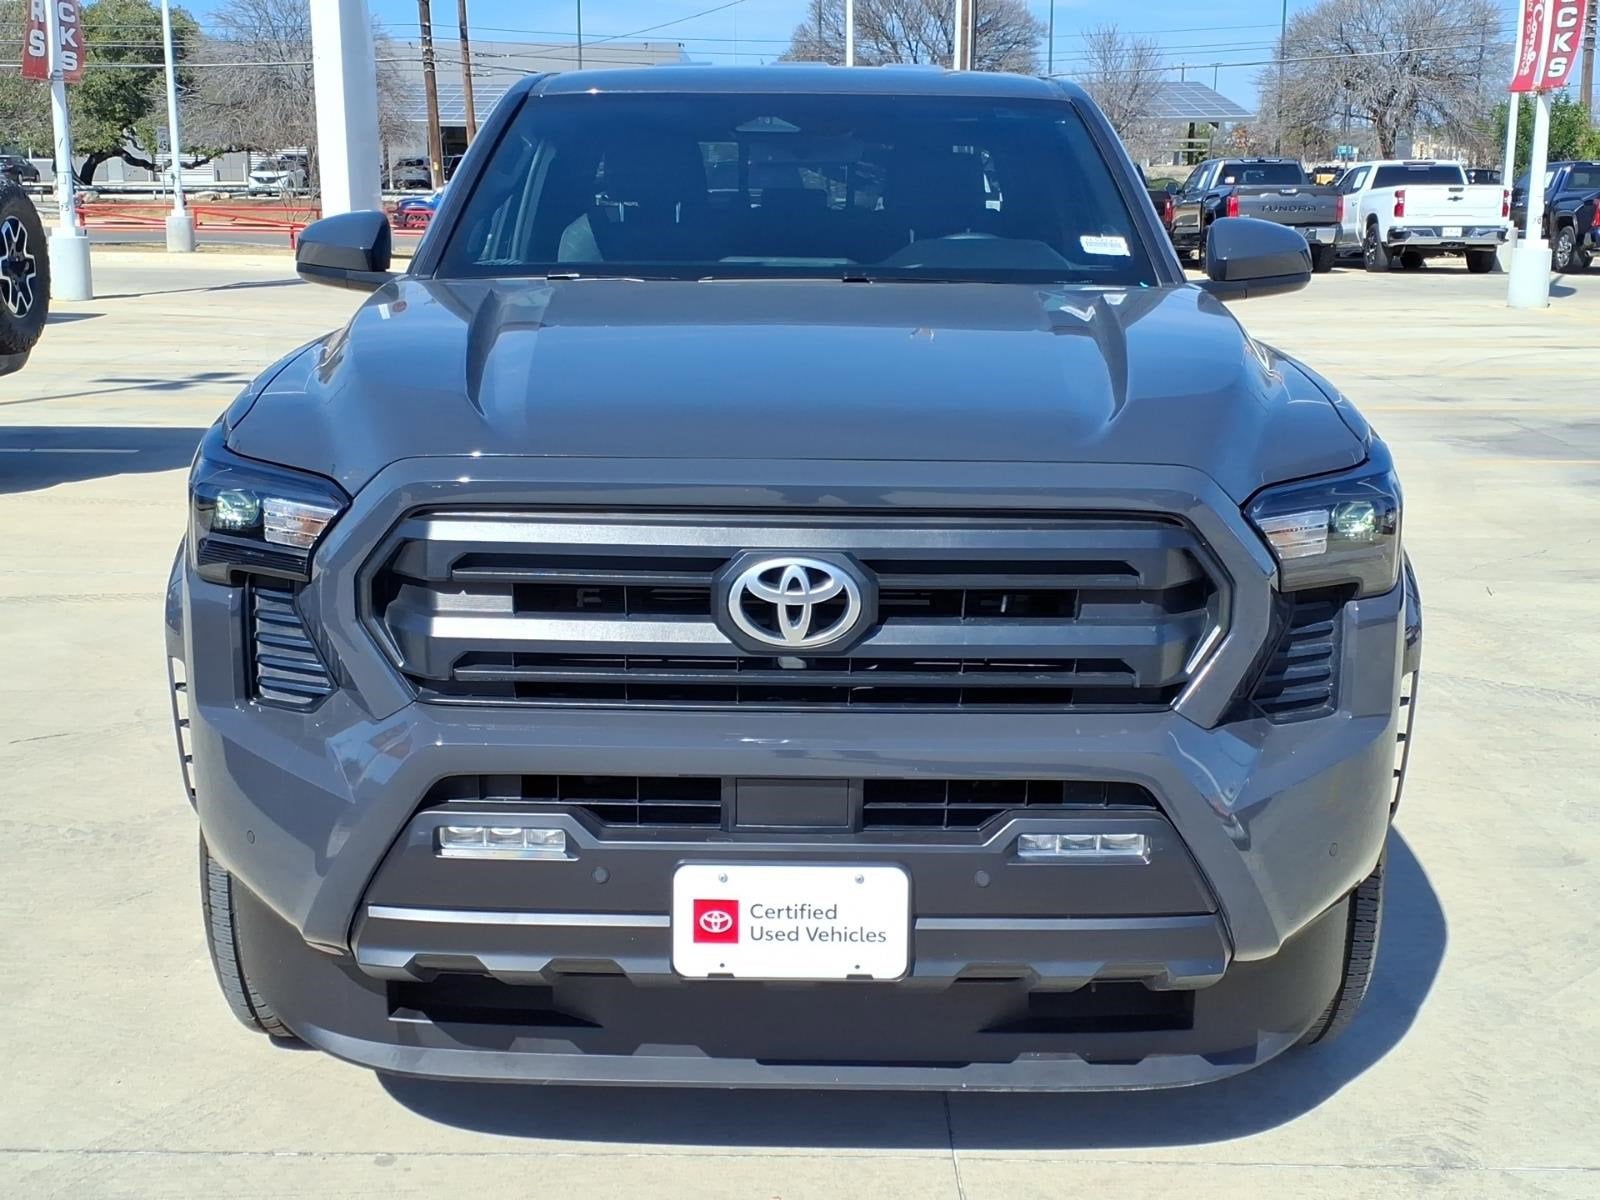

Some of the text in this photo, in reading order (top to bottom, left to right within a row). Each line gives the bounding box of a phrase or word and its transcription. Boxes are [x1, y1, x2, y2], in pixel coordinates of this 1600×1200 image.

[1548, 0, 1578, 77] CKS
[1261, 205, 1317, 213] TUNDRA
[750, 904, 837, 920] Certified
[750, 926, 887, 943] Used Vehicles
